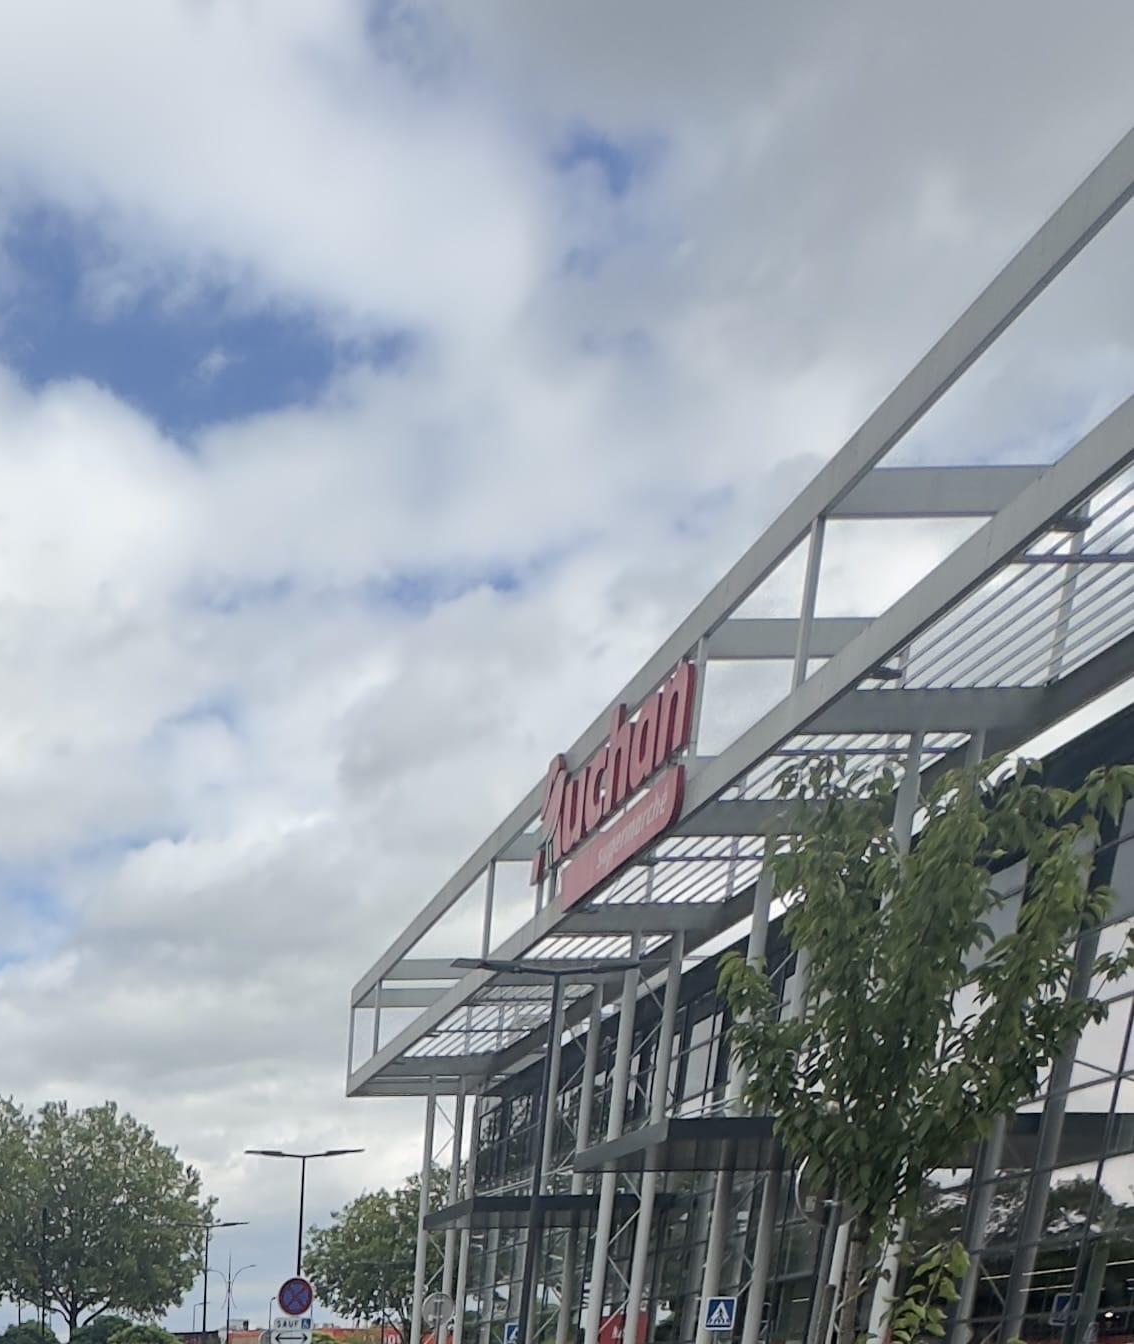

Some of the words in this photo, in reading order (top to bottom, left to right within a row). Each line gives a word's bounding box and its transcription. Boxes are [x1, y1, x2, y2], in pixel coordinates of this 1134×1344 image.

[530, 657, 696, 886] Auchan
[596, 784, 669, 871] Supermarché
[276, 1320, 299, 1328] SAUF
